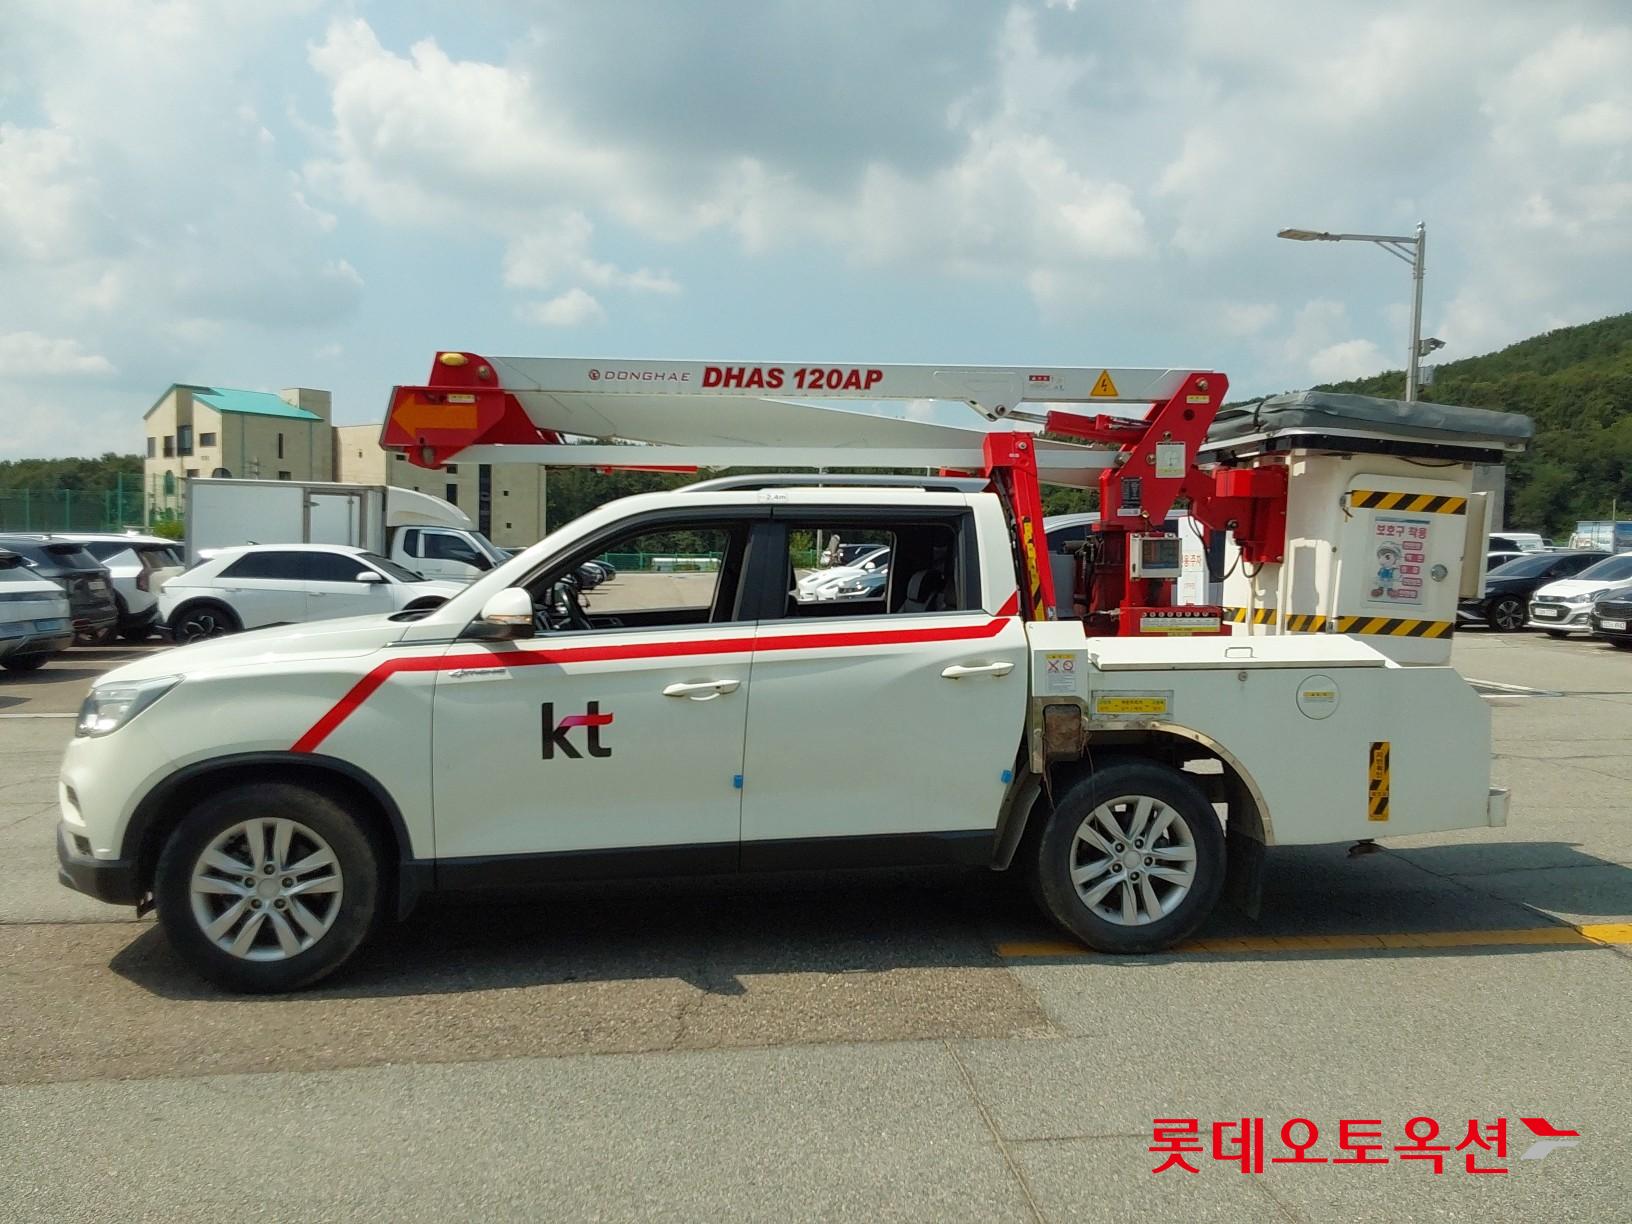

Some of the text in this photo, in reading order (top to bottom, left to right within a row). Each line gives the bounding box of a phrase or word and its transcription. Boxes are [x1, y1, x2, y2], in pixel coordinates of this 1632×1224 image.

[605, 366, 883, 390] DONGHAE DHAS 120AP
[1376, 525, 1427, 539] 보호구 착용
[541, 701, 613, 759] kt
